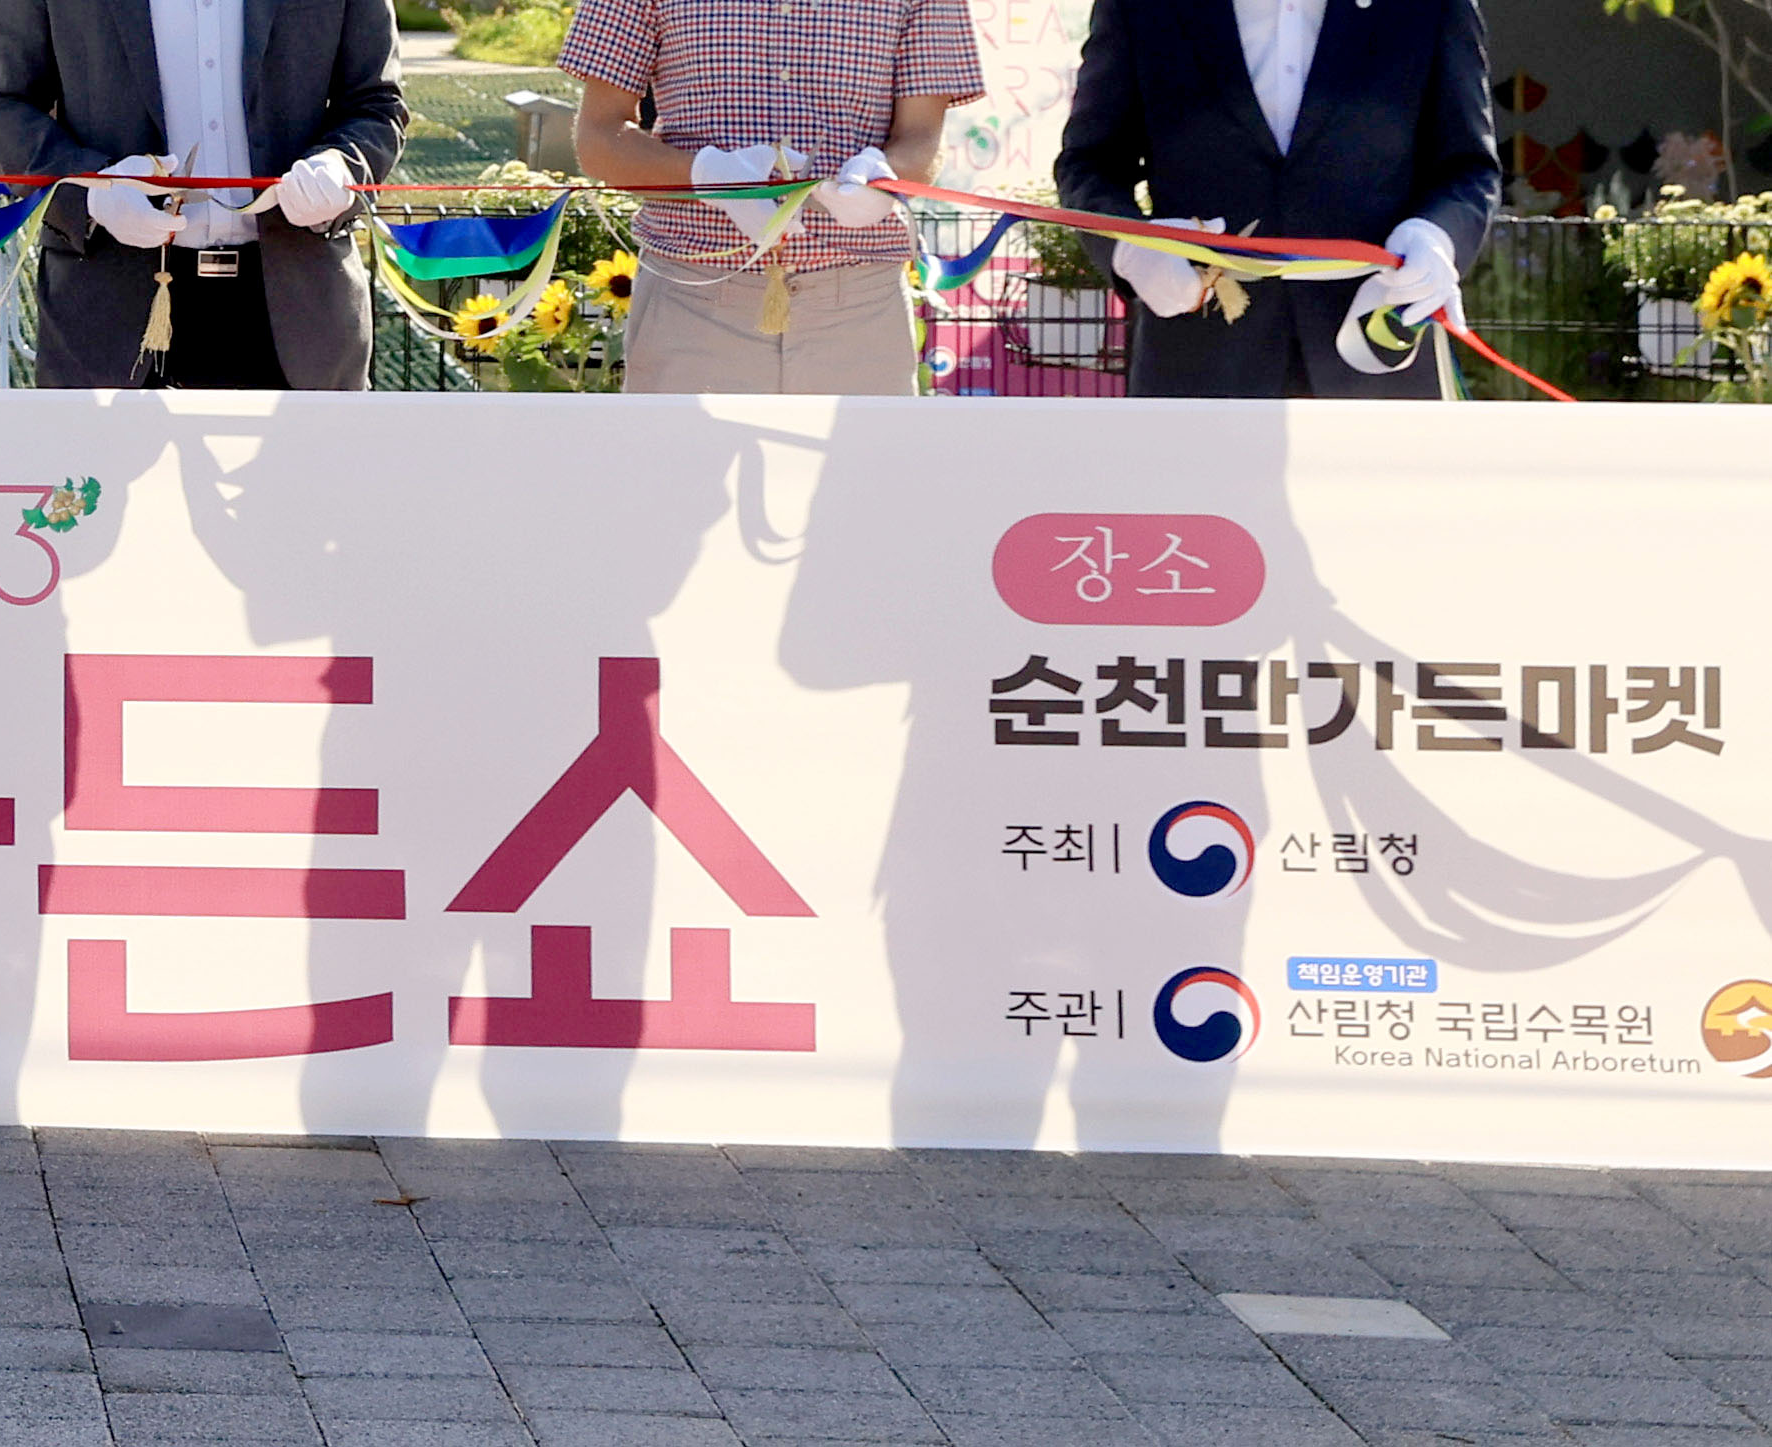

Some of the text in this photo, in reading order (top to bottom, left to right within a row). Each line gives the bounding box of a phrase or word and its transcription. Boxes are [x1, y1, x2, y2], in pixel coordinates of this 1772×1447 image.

[1049, 526, 1217, 604] 장소
[988, 654, 1726, 757] 순천만가든마켓
[1279, 832, 1419, 876] 산림청
[1296, 961, 1429, 989] 책임운영기관
[1287, 998, 1416, 1042] 산림청
[1435, 1001, 1655, 1047] 국립수목원
[1334, 1045, 1702, 1075] Korea National Arboretum
